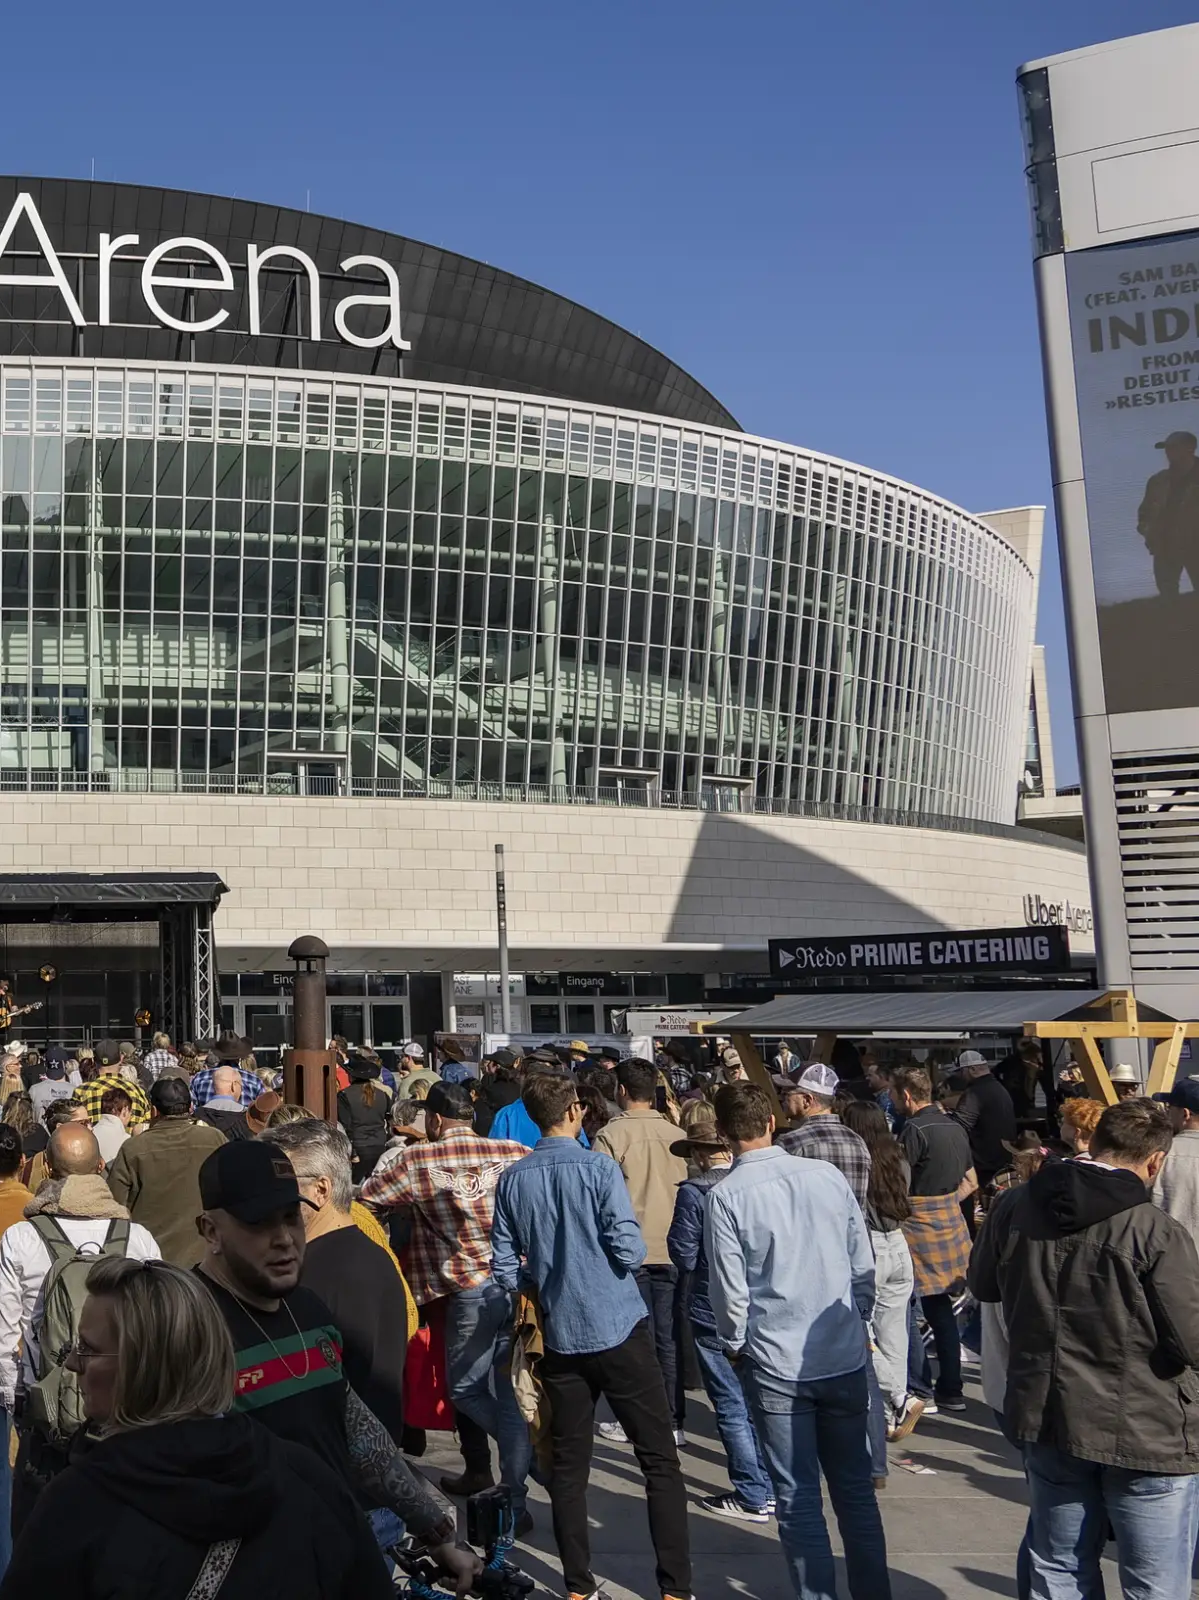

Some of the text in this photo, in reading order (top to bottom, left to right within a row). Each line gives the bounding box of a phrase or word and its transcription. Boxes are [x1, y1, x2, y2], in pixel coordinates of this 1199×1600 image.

[1119, 266, 1164, 285] SAM
[1085, 287, 1147, 309] (FEAT.
[1142, 350, 1199, 370] FROM
[1124, 369, 1191, 391] DEBUT
[1105, 385, 1199, 410] »RESTLES
[1022, 893, 1094, 933] Uber Arena
[796, 936, 1050, 968] Redo PRIME CATERING
[454, 976, 471, 985] AST
[454, 986, 473, 995] ANE
[566, 976, 604, 988] Eingang
